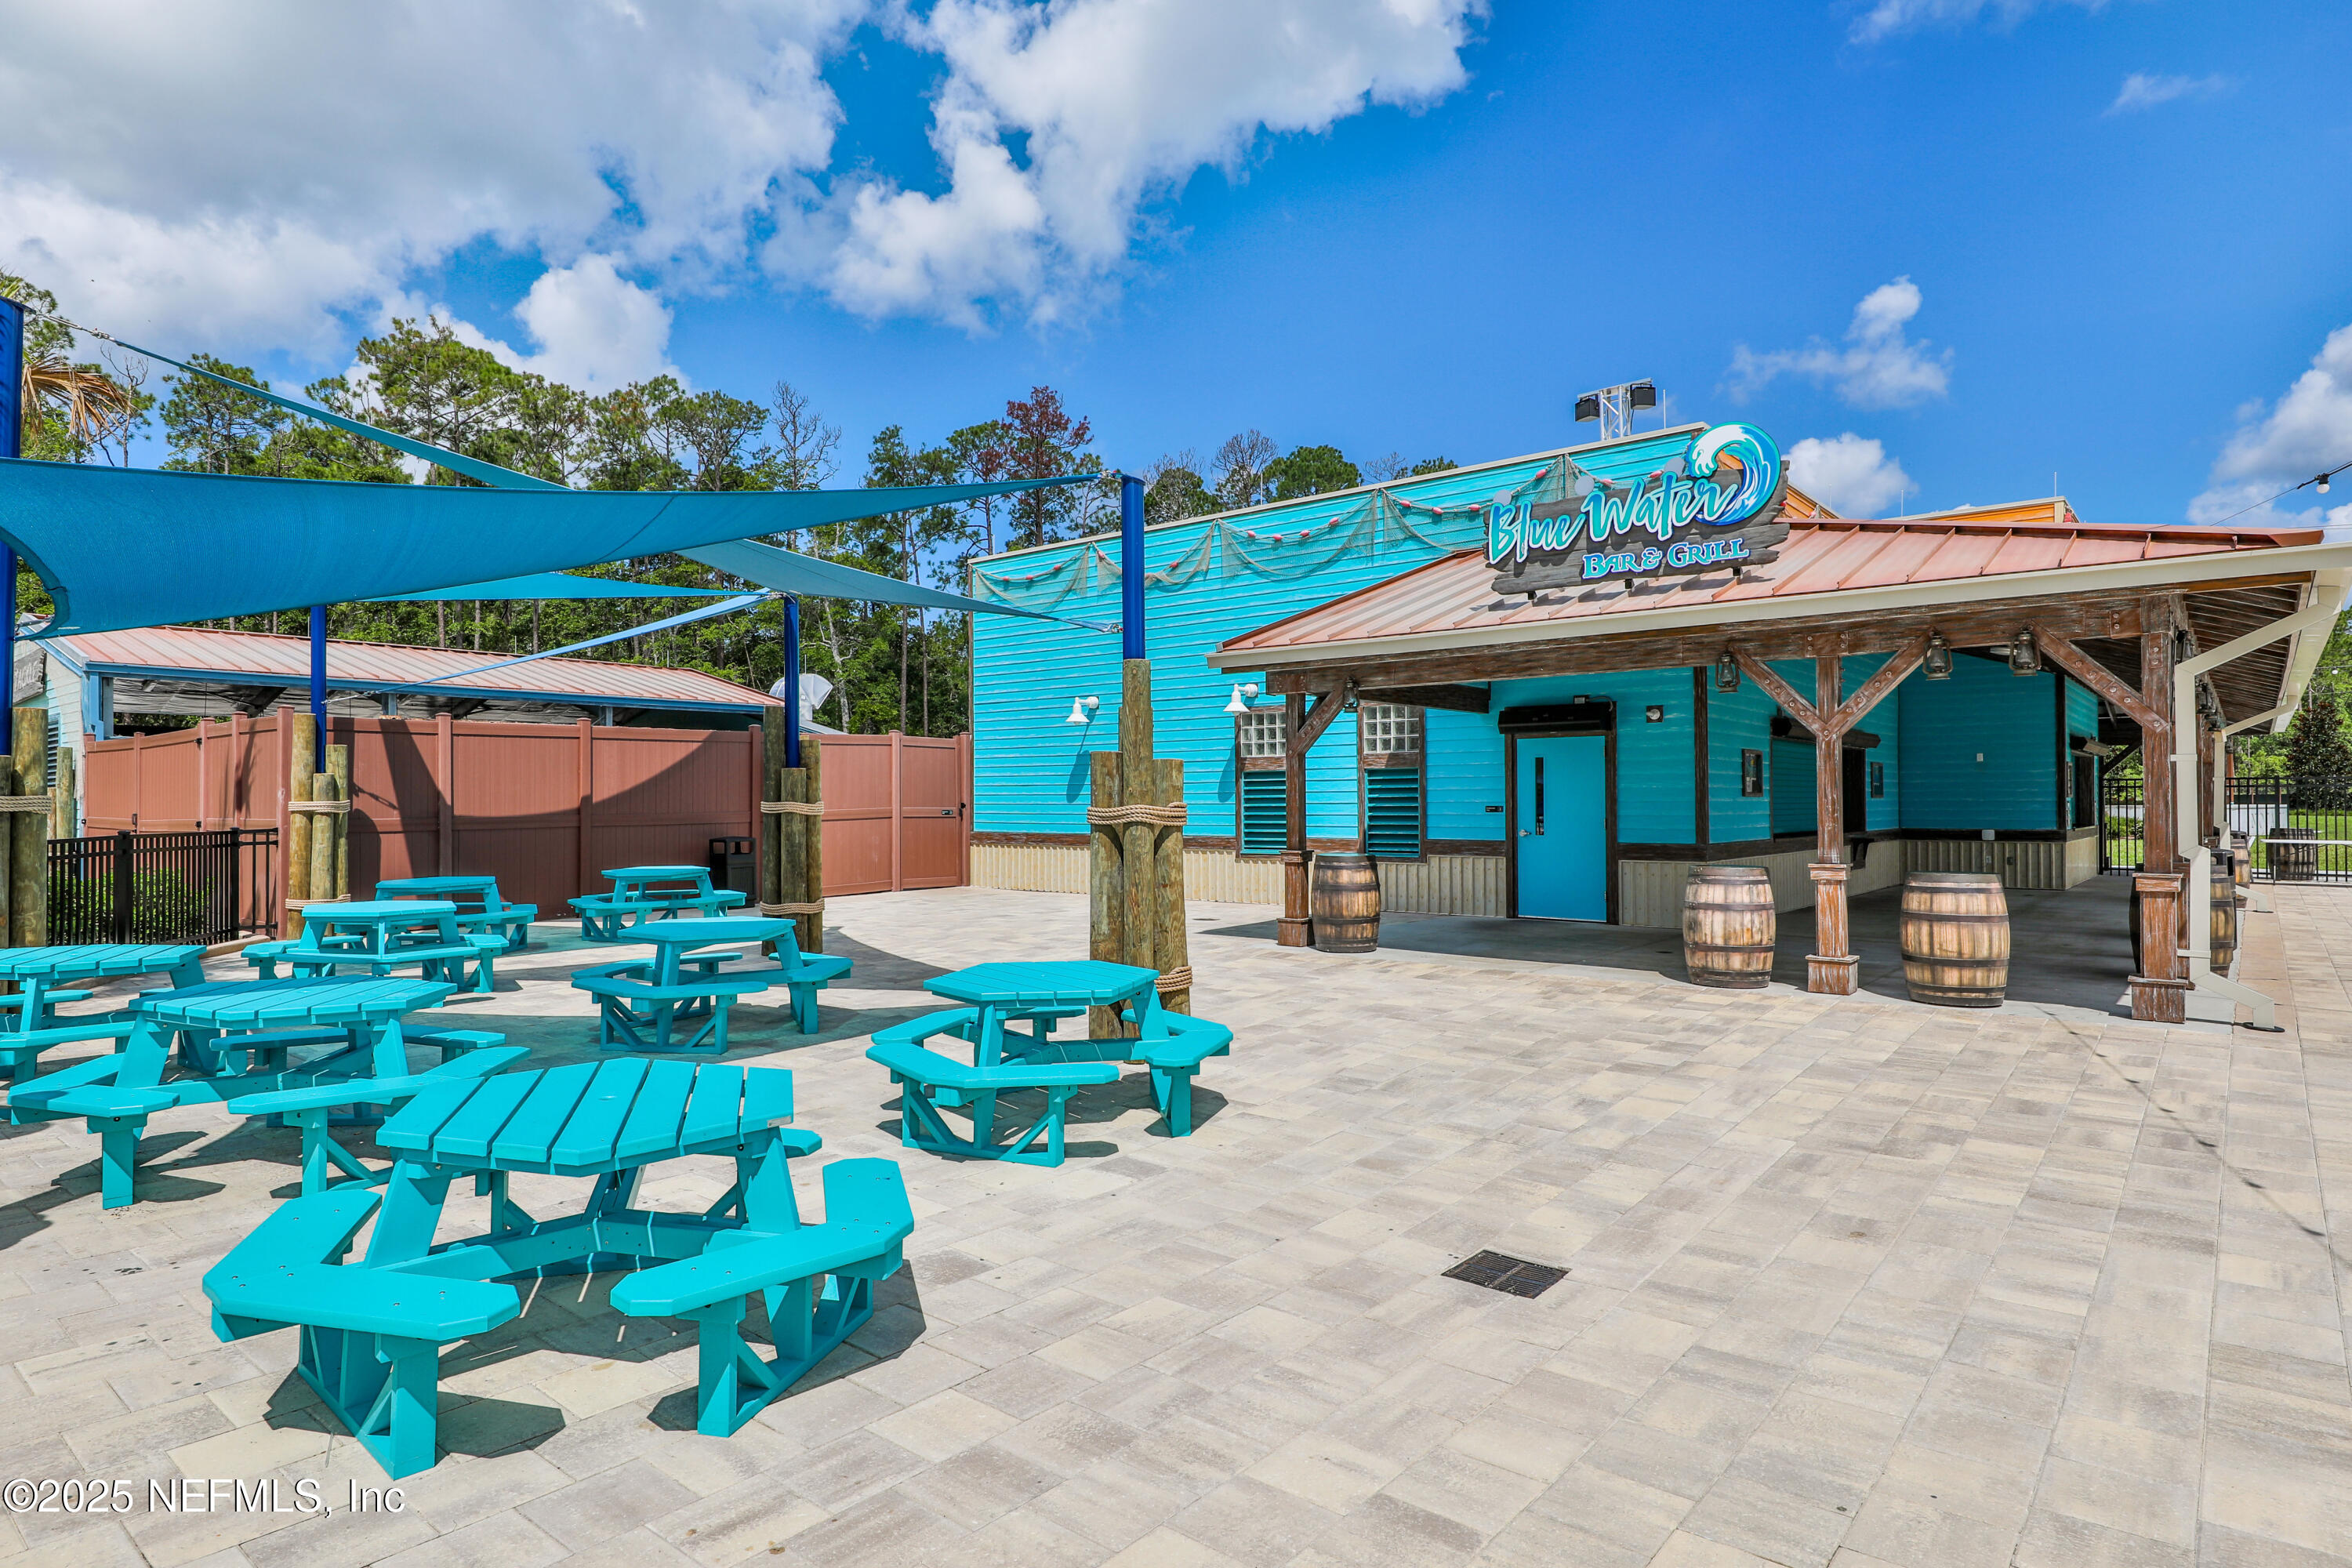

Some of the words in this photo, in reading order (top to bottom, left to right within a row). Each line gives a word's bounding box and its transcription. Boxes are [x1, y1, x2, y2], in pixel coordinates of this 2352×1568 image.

[1489, 502, 1588, 564] Blue
[1581, 470, 1739, 542] Water
[1582, 553, 1643, 579] BAR
[1641, 546, 1663, 571] &
[1667, 538, 1750, 568] GRILL
